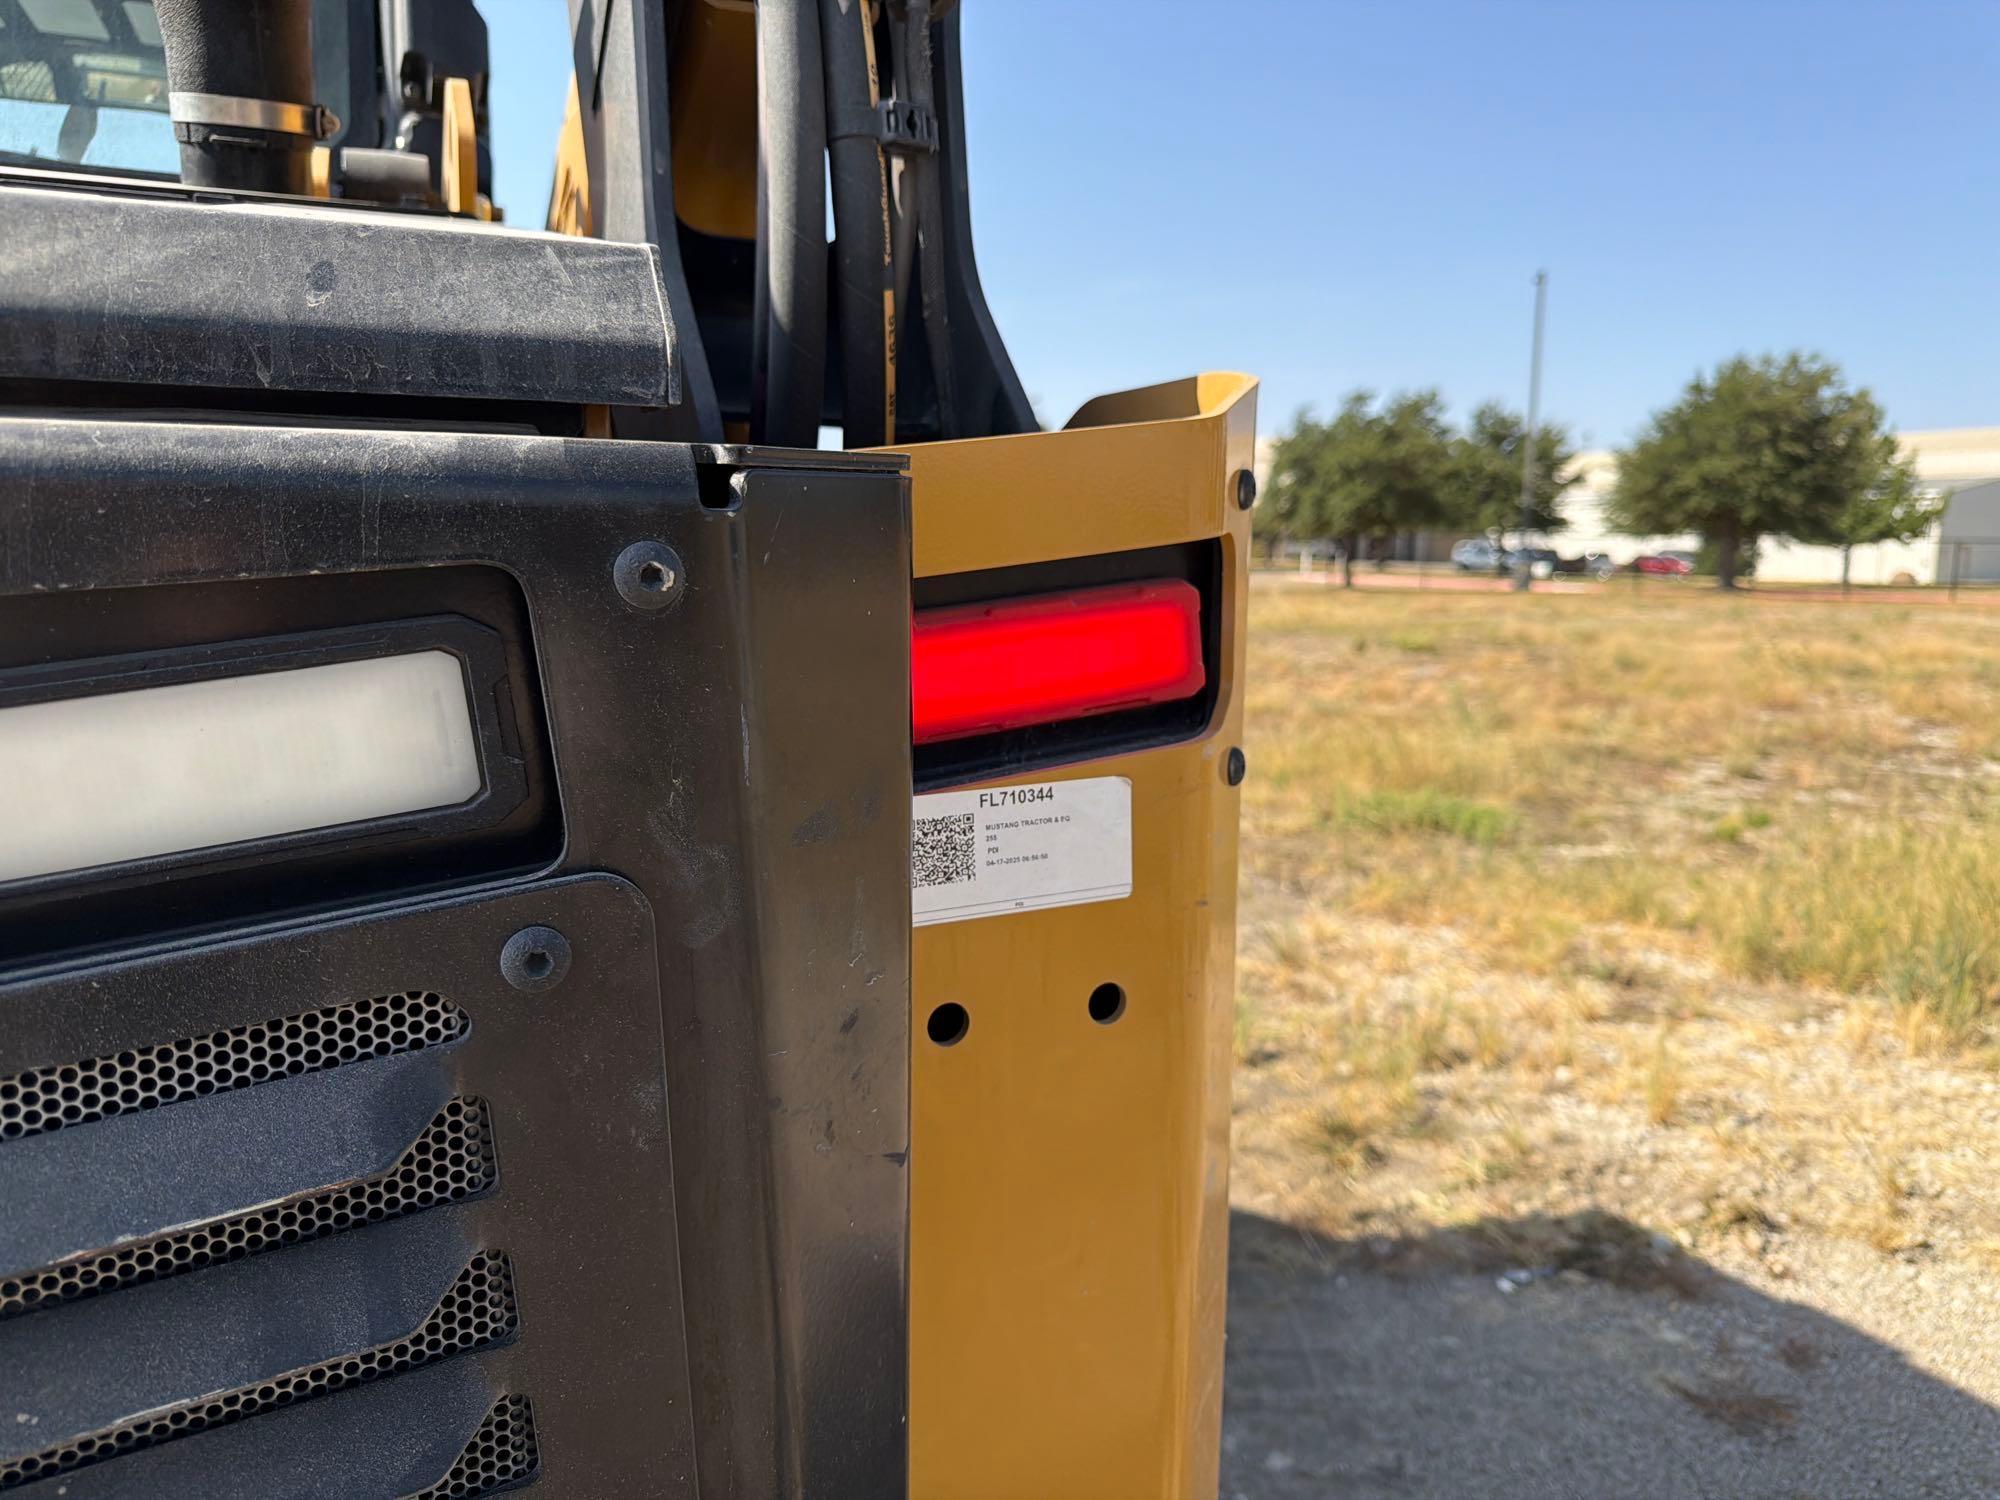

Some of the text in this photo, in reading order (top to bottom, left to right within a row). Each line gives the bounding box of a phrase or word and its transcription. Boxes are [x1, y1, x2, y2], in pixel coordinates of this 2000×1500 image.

[979, 786, 1055, 808] FL710344
[985, 821, 1020, 831] MUSTANG
[1021, 817, 1053, 828] TRACTOR
